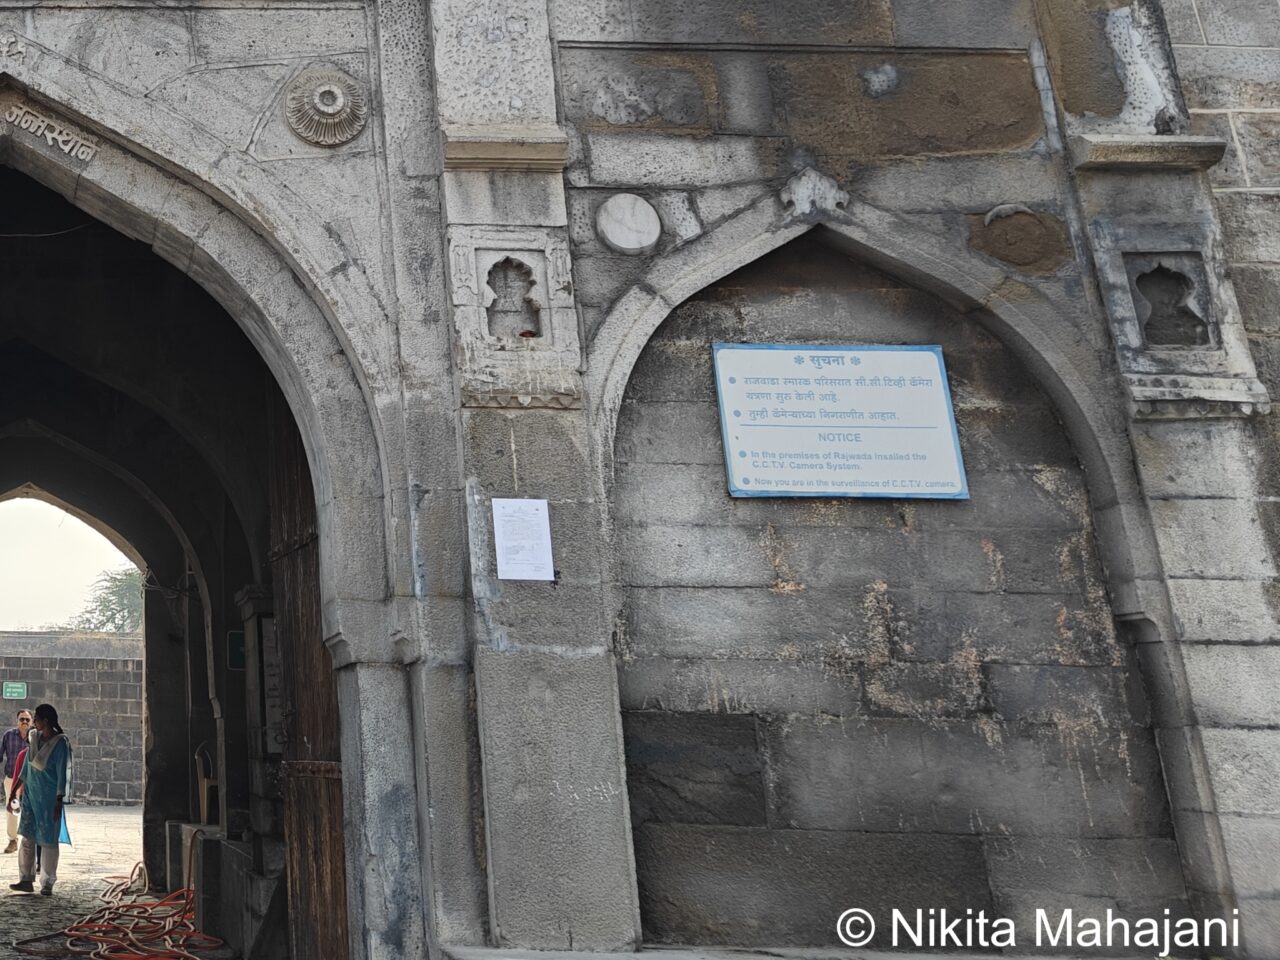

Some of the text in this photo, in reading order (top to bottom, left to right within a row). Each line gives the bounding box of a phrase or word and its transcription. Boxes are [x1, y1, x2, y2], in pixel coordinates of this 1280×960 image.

[4, 104, 101, 162] जन्मस्थान
[743, 377, 779, 385] राजवाडा
[782, 378, 811, 386] स्मारक
[814, 375, 852, 387] परिसरात
[794, 390, 815, 401] केली
[818, 433, 863, 442] NOTICE
[751, 450, 760, 458] In
[778, 451, 820, 460] premises
[833, 452, 872, 461] Rajwada
[789, 461, 824, 469] Camera
[774, 479, 790, 487] you
[882, 479, 890, 487] of
